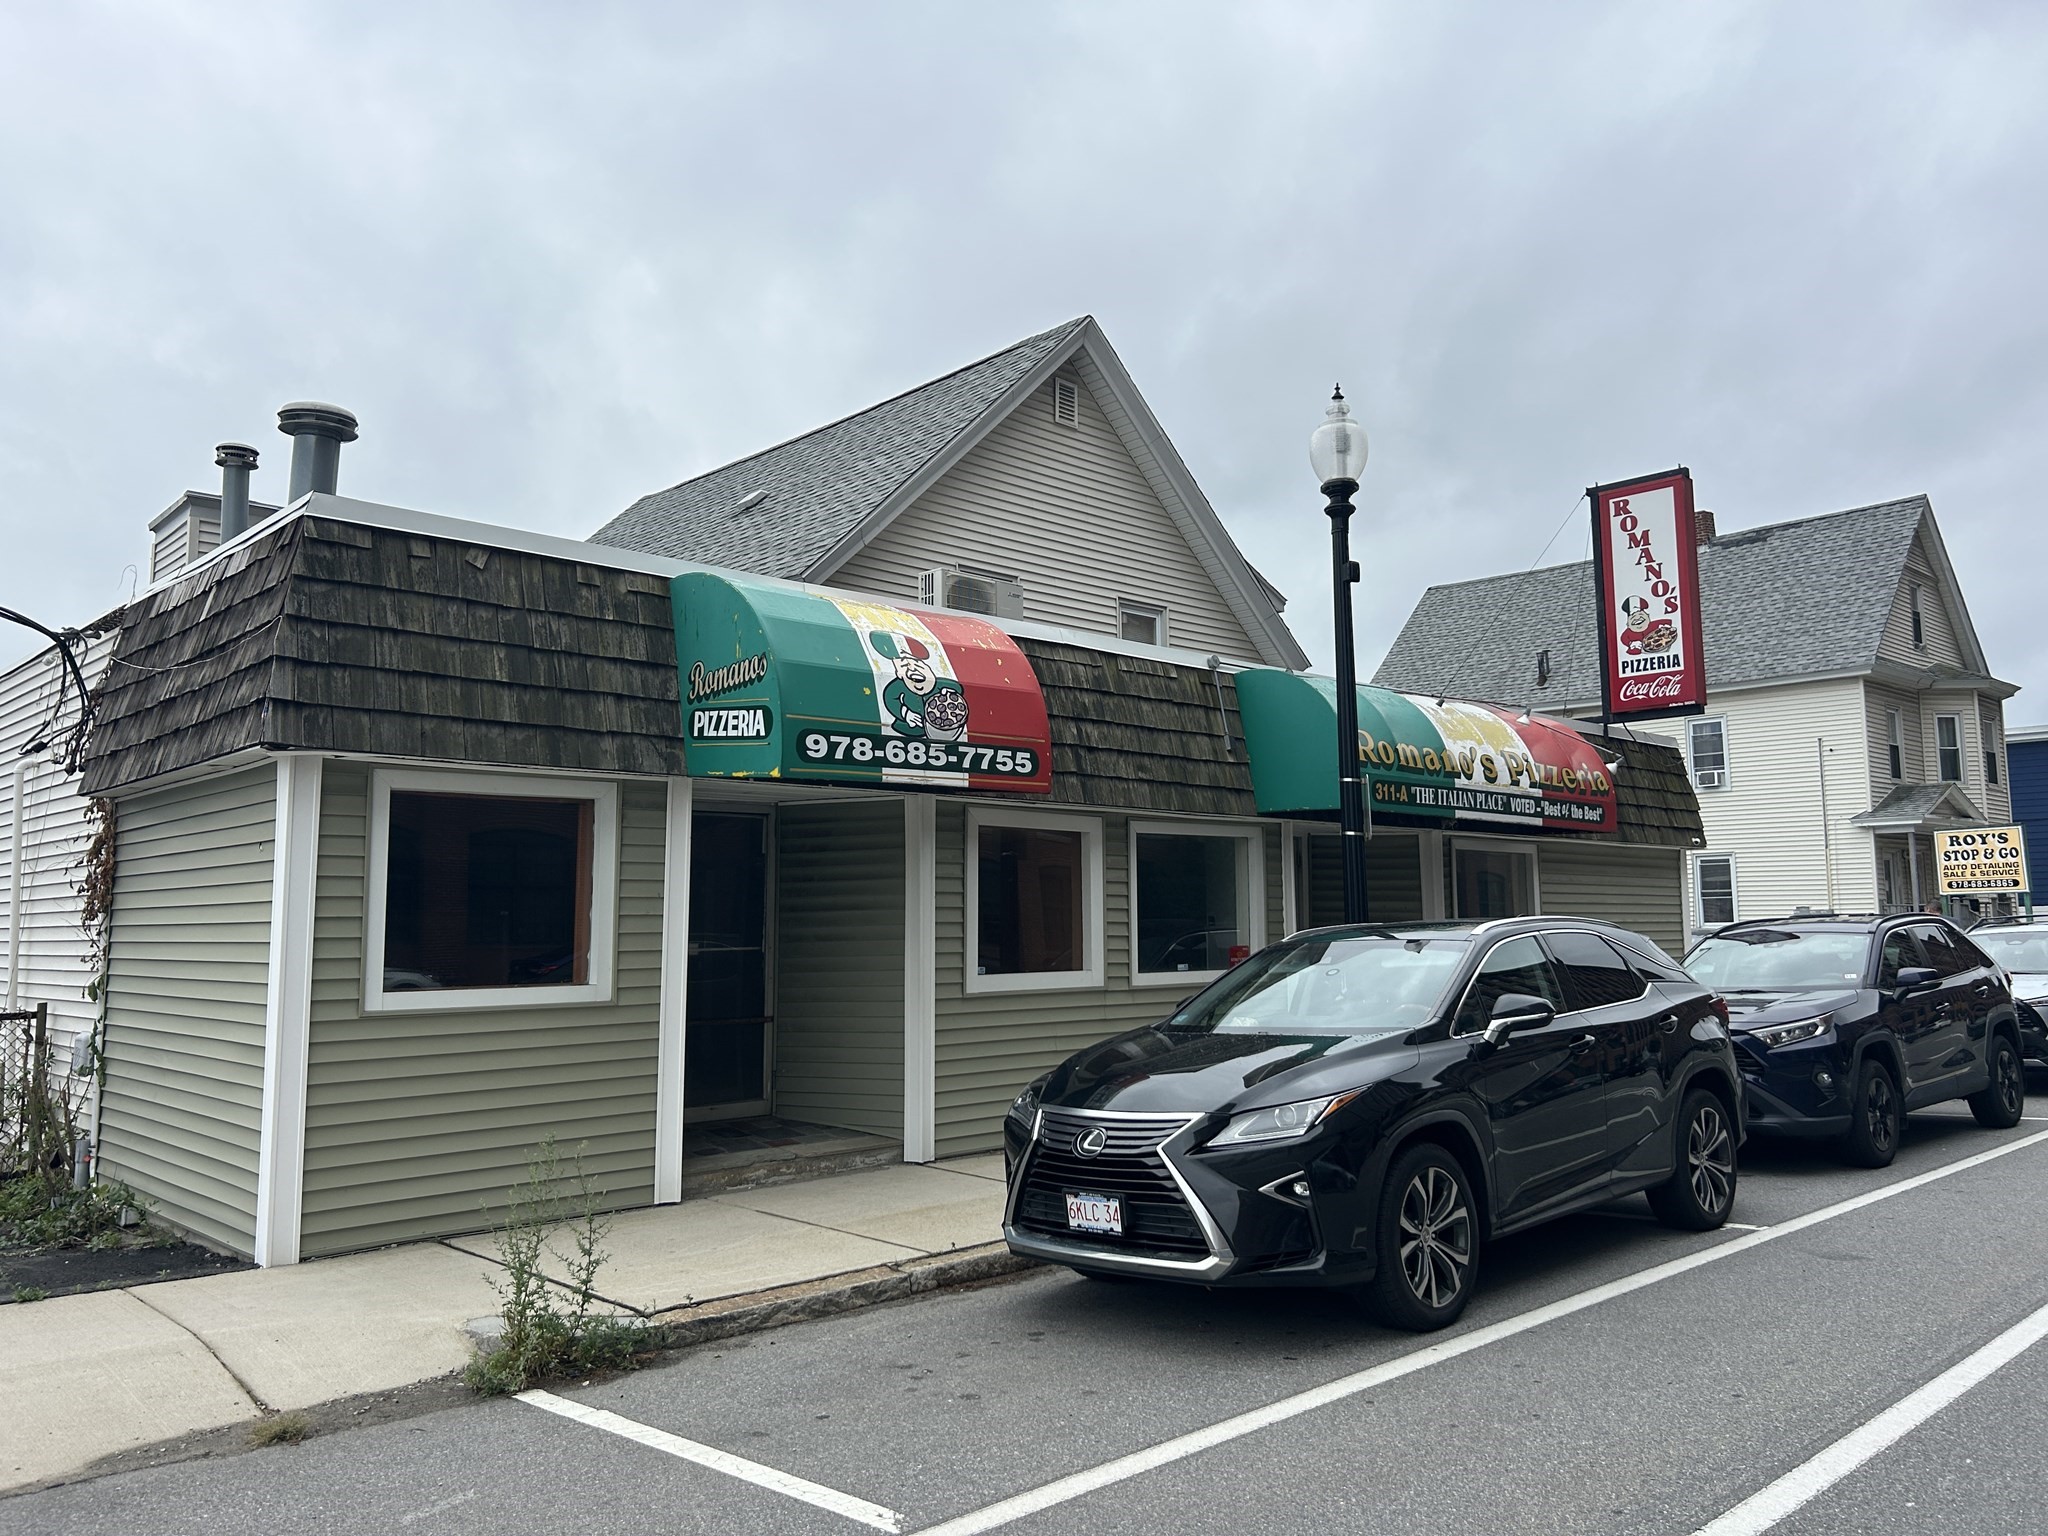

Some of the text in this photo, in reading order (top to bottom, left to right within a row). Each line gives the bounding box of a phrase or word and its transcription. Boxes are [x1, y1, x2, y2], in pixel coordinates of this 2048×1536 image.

[1612, 498, 1679, 615] ROMANO'S
[688, 653, 767, 702] Romanos
[1621, 653, 1681, 675] PIZZERIA
[1619, 673, 1685, 702] Coca-Cola
[693, 709, 766, 737] PIZZERIA
[804, 733, 1033, 774] 978-685-7755
[1357, 729, 1611, 795] Romano's Pizzeria
[1375, 782, 1409, 802] 311-A
[1411, 786, 1436, 805] "THE
[1437, 788, 1476, 808] ITALIAN
[1510, 797, 1536, 814] VOTED
[1561, 803, 1570, 819] of
[1571, 804, 1584, 819] the
[1948, 832, 2009, 846] ROY'S
[1943, 847, 2019, 861] STOP & GO
[1970, 862, 2020, 870] DETAILING
[1979, 869, 2020, 877] SERVICE
[1069, 1201, 1120, 1224] 6KLC 34
